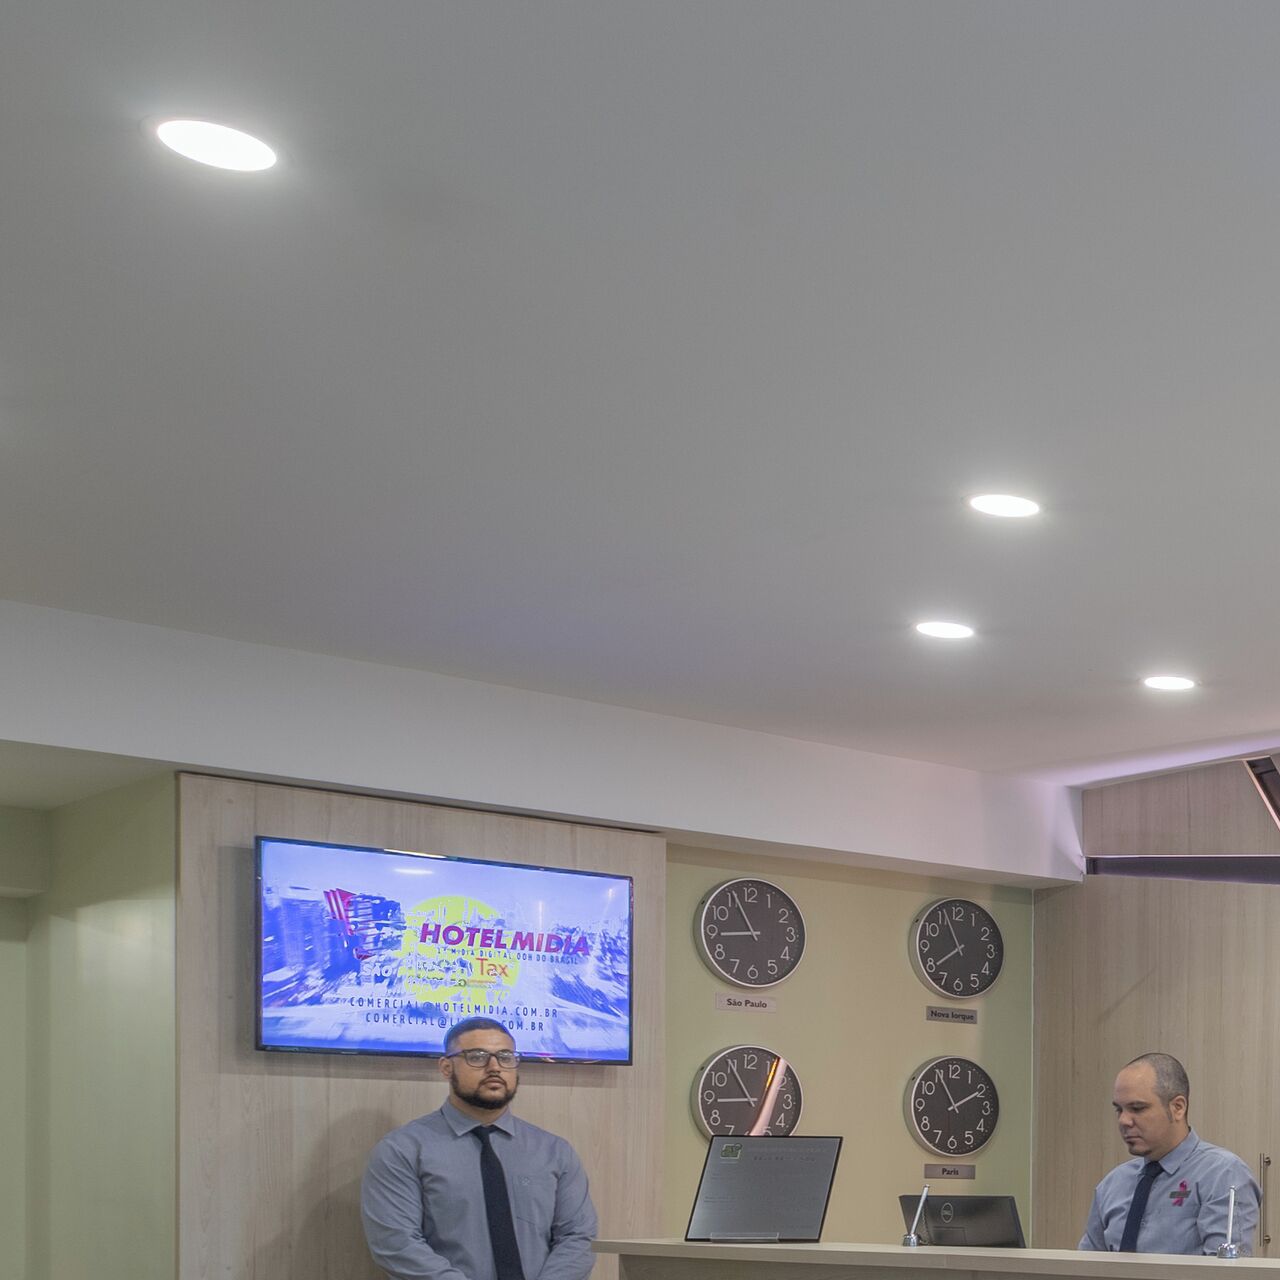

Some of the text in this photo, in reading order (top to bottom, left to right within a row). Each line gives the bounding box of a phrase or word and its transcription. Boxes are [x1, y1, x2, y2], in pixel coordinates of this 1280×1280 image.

[744, 887, 758, 903] 12
[766, 894, 771, 908] 1
[712, 905, 729, 920] 10
[778, 908, 789, 923] 2
[952, 906, 964, 921] 12
[706, 924, 718, 939] 9
[786, 927, 795, 942] 3
[925, 922, 939, 937] 10
[981, 927, 990, 941] 2
[715, 944, 725, 960] 8
[780, 946, 790, 960] 4
[920, 939, 930, 953] 9
[986, 944, 995, 959] 3
[475, 957, 510, 978] Tax
[730, 959, 740, 973] 7
[747, 965, 758, 979] 6
[767, 960, 778, 974] 5
[926, 957, 935, 973] 8
[982, 961, 990, 975] 4
[939, 972, 948, 985] 7
[953, 978, 963, 991] 6
[970, 974, 979, 988] 5
[727, 998, 768, 1009] São Paulo
[931, 1010, 949, 1018] Nova
[743, 1054, 758, 1069] 12
[948, 1064, 961, 1079] 12
[711, 1071, 728, 1087] 10
[921, 1081, 935, 1095] 10
[976, 1084, 986, 1097] 2
[703, 1090, 715, 1105] 9
[782, 1094, 793, 1109] 3
[915, 1098, 925, 1112] 9
[982, 1101, 991, 1115] 3
[710, 1109, 721, 1125] 8
[775, 1113, 785, 1128] 4
[921, 1116, 930, 1131] 8
[725, 1125, 735, 1136] 7
[976, 1118, 984, 1132] 4
[933, 1130, 942, 1144] 7
[947, 1136, 957, 1149] 6
[964, 1131, 974, 1145] 5
[942, 1168, 959, 1176] Paris
